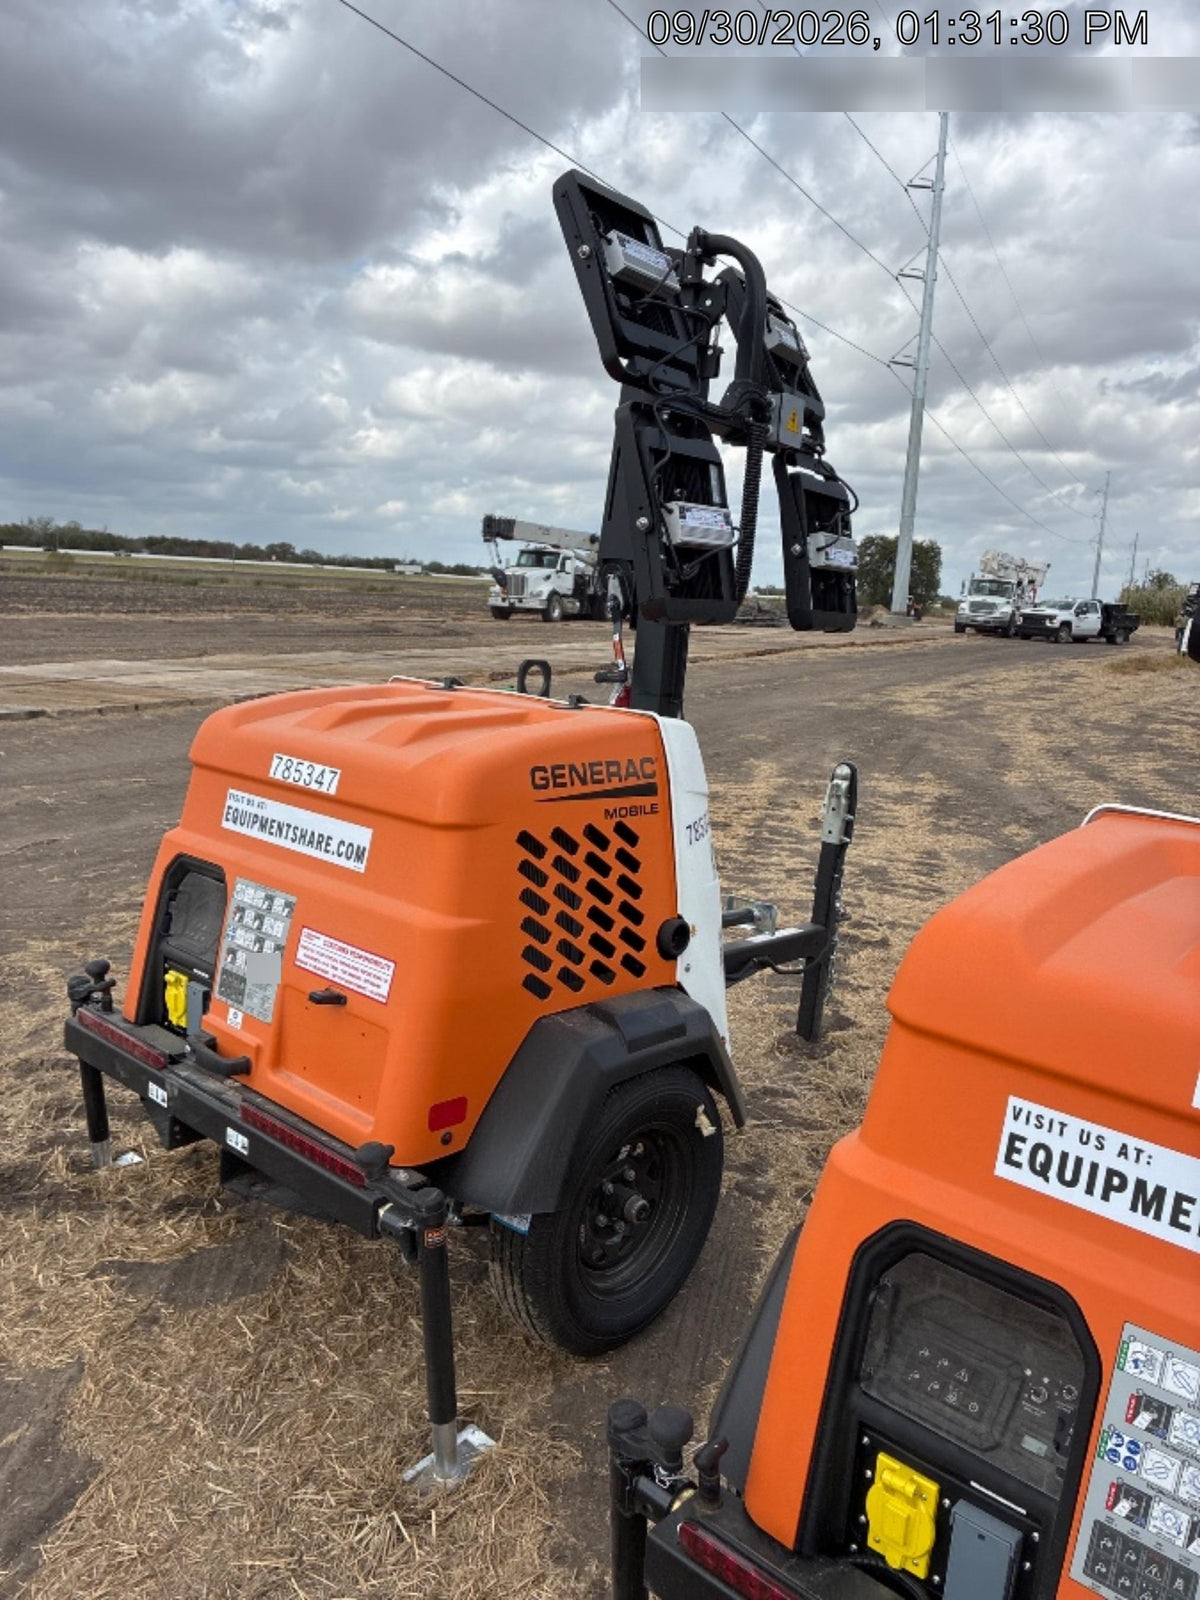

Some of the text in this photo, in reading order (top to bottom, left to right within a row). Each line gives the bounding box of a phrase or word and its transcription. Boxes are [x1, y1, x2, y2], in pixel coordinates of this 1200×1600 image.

[273, 755, 338, 792] 785347
[530, 757, 655, 790] GENERAC
[224, 804, 367, 866] EQUIPMENTSHARE.COM
[603, 802, 659, 820] MOBILE
[1011, 1104, 1154, 1166] VISIT US AT:
[1003, 1131, 1200, 1238] EQUIPME
